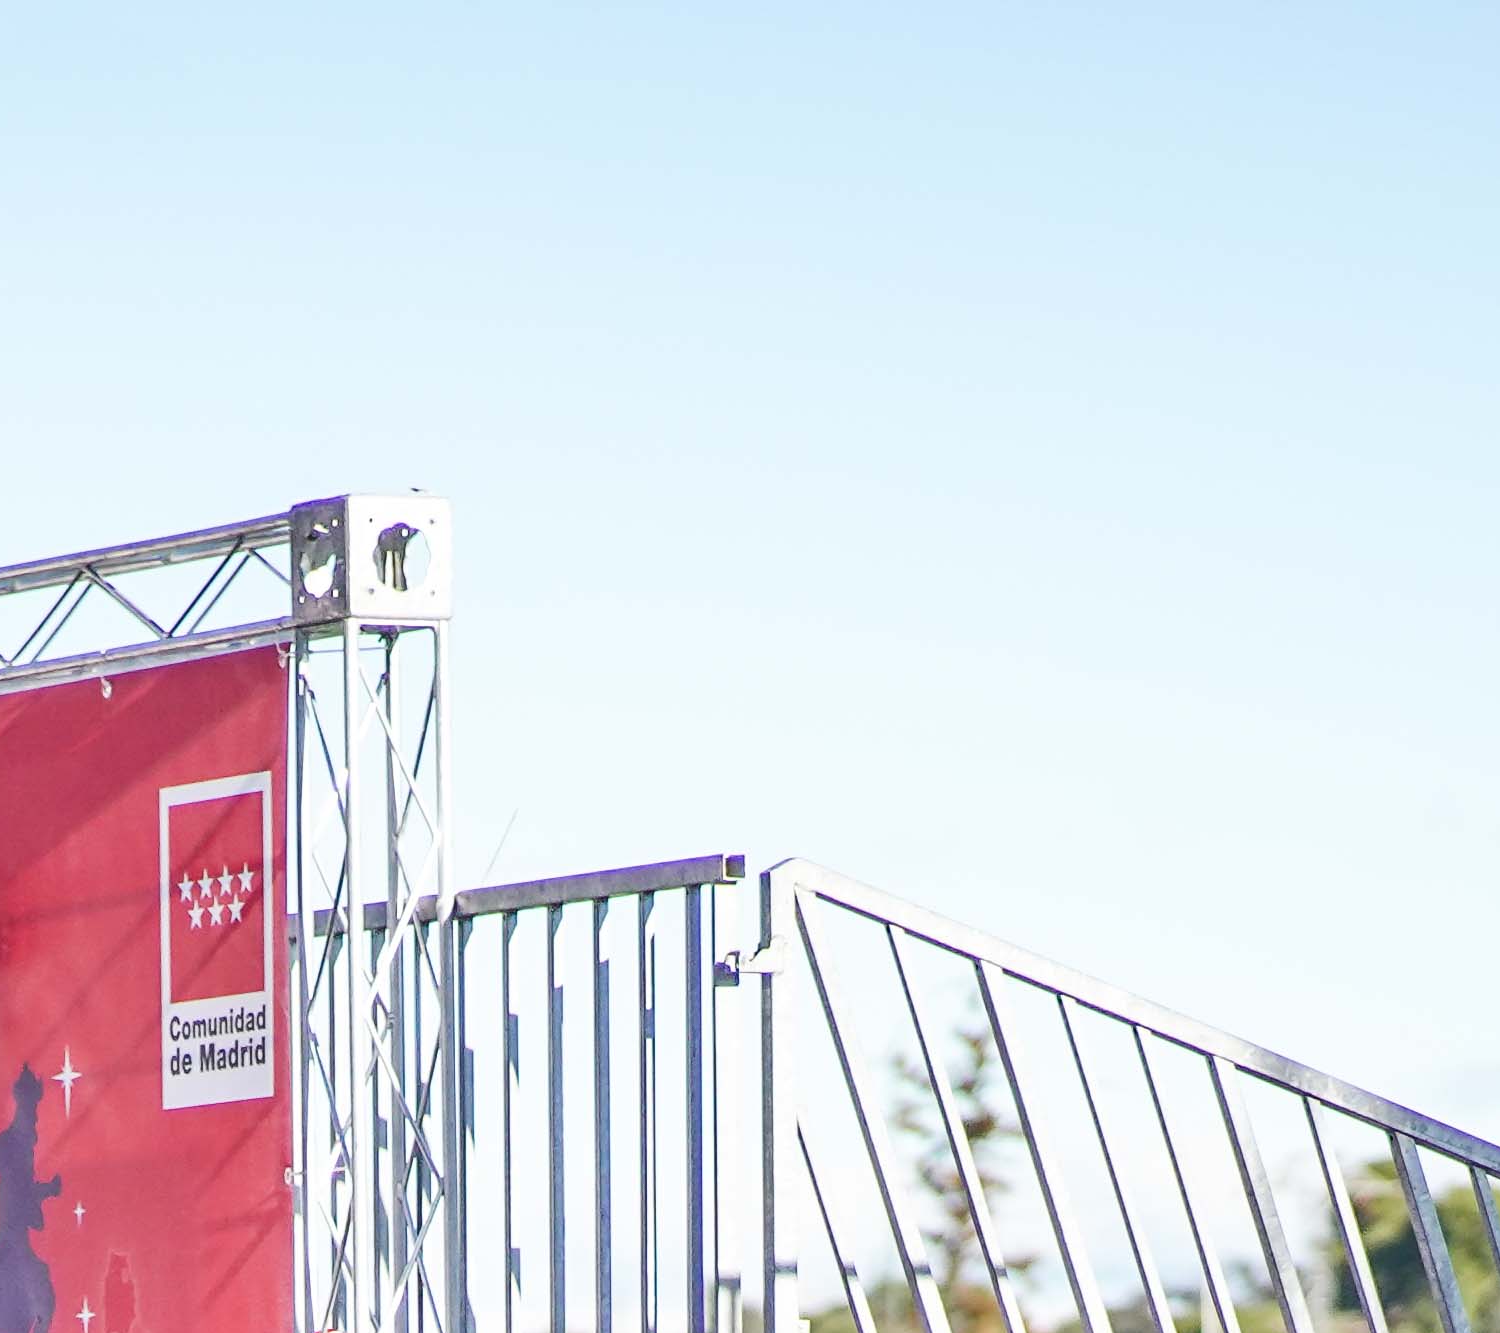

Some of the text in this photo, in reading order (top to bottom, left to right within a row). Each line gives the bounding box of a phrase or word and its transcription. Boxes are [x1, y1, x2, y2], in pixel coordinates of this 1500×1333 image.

[169, 1003, 267, 1042] Comunidad
[170, 1035, 267, 1077] de Madrid
